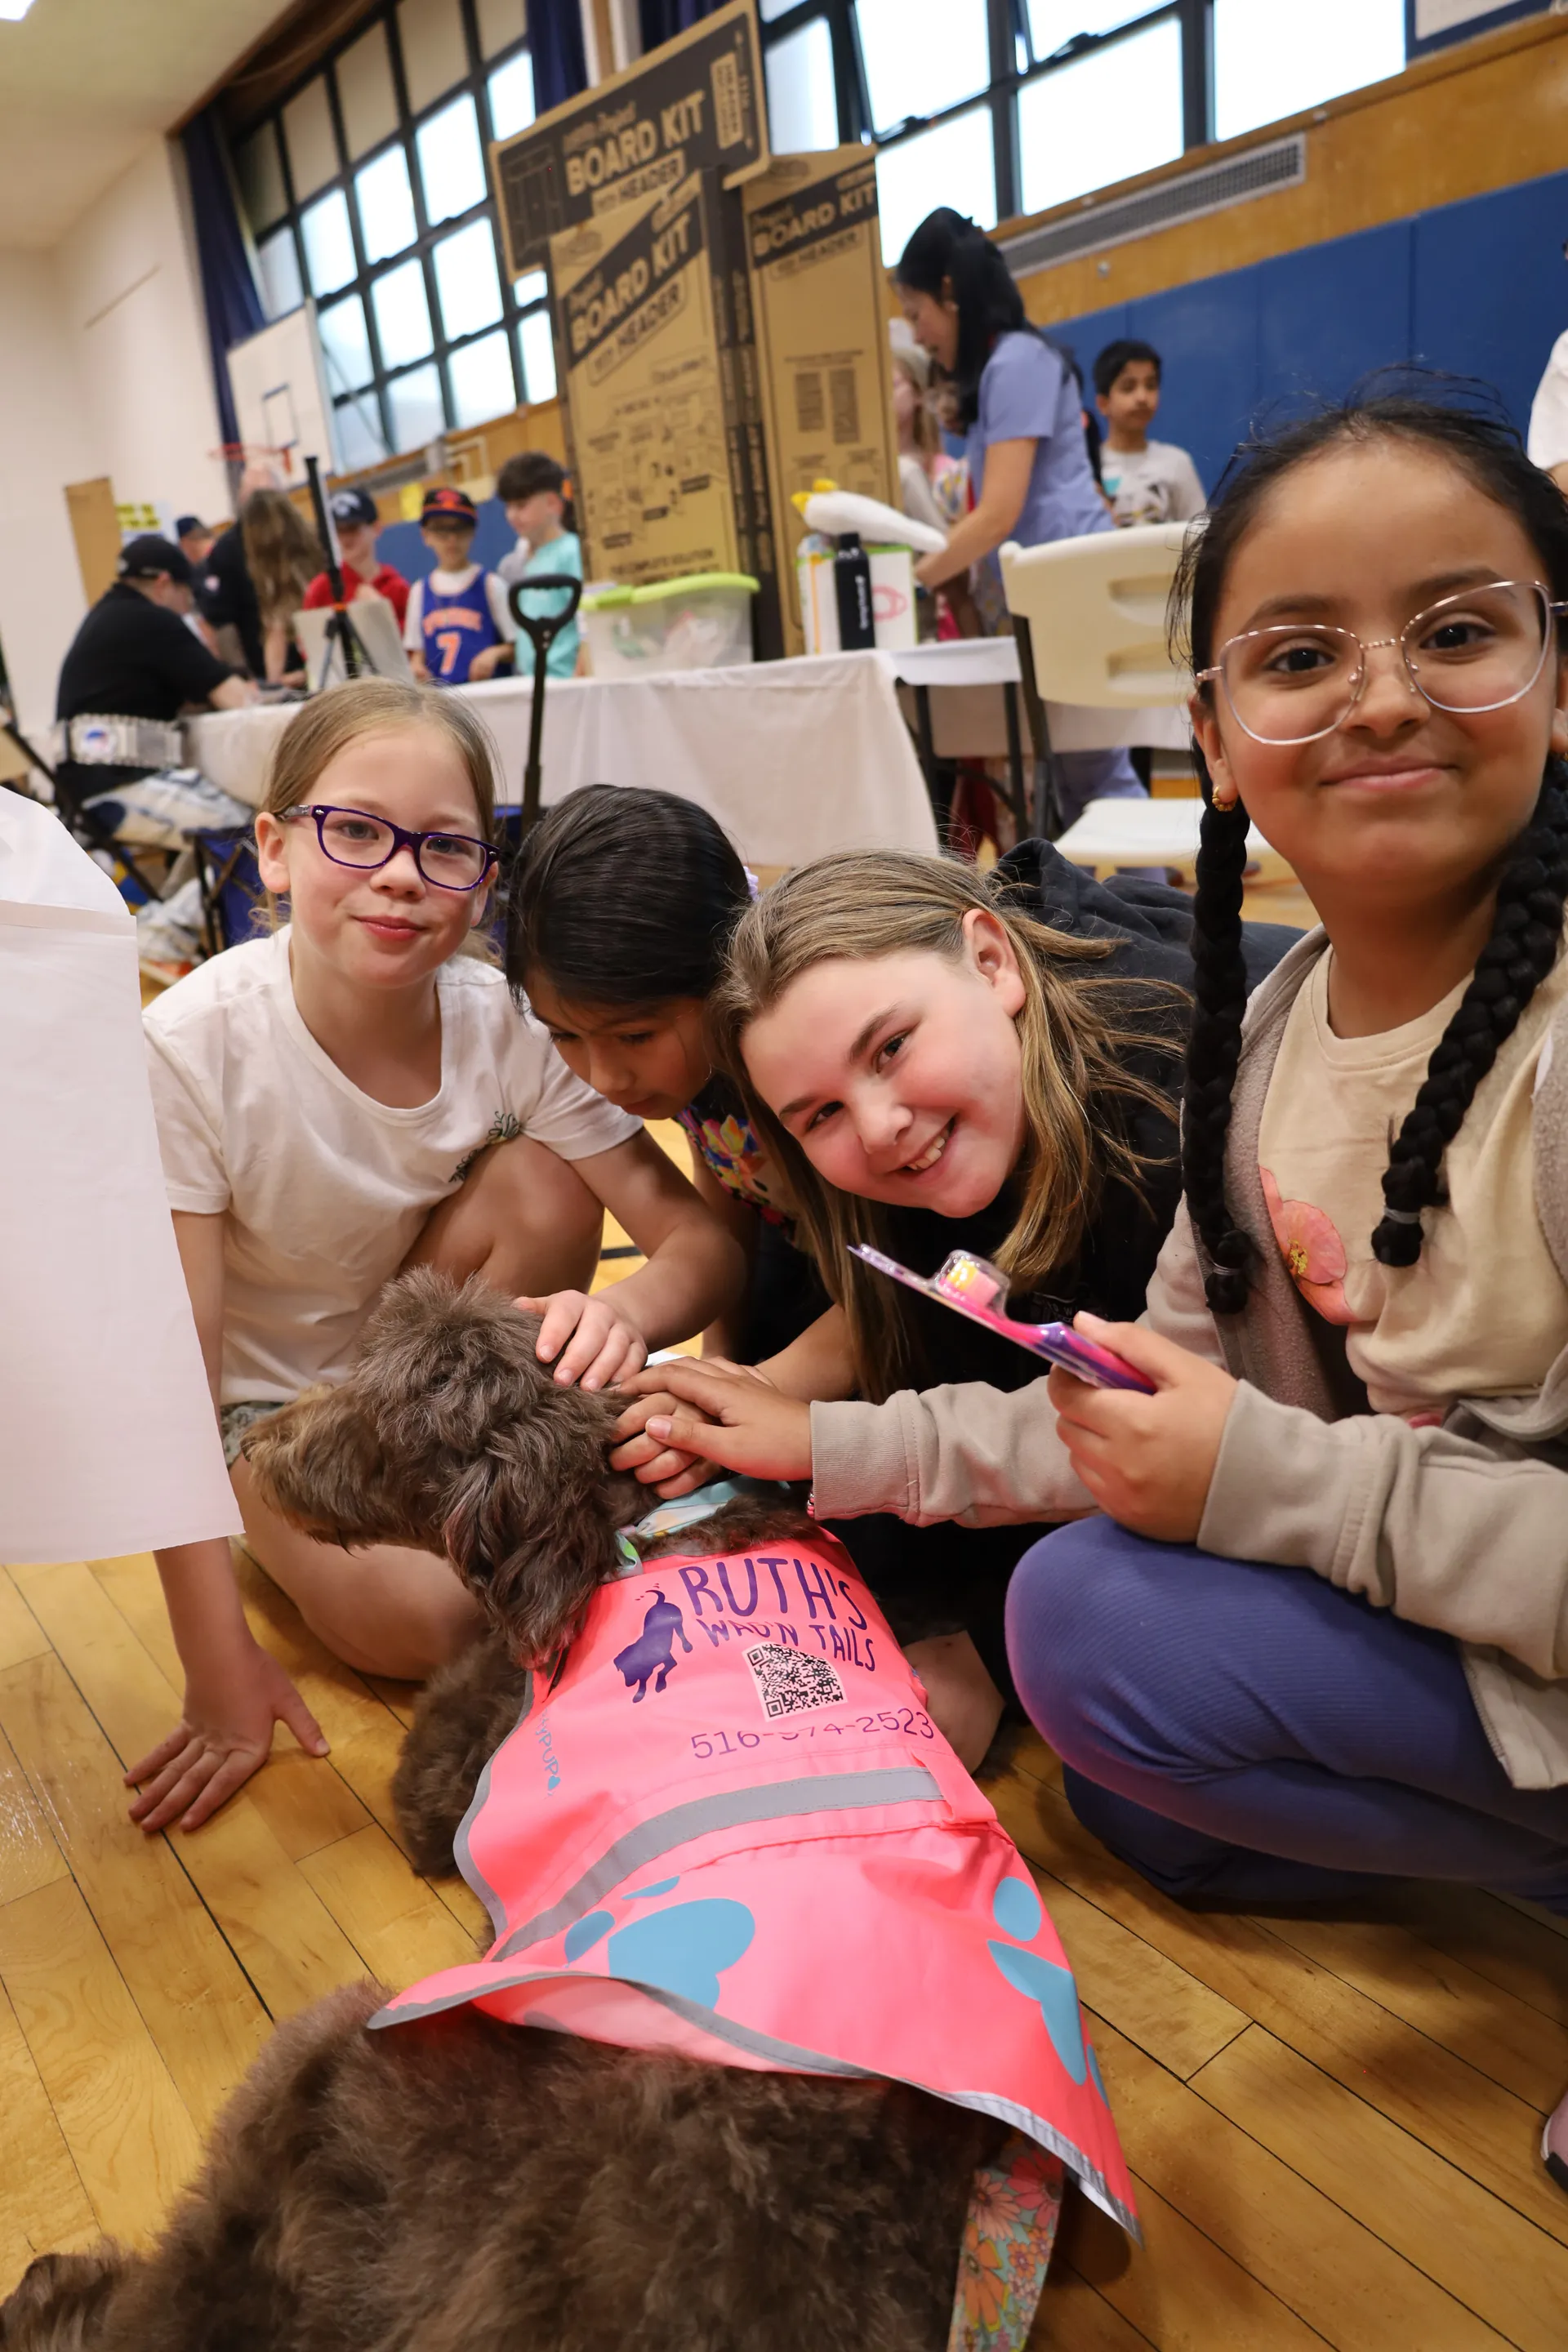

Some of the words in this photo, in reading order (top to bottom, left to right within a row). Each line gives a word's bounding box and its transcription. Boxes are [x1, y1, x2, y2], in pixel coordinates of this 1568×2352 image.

[566, 120, 657, 197] BOARD
[661, 90, 706, 148] KIT
[753, 203, 836, 257] BOARD
[840, 180, 876, 217] KIT
[572, 258, 649, 354] BOARD
[652, 212, 691, 278] KIT
[435, 631, 461, 676] 7
[679, 1557, 868, 1631] RUTH'S
[808, 1624, 875, 1673] TAILS
